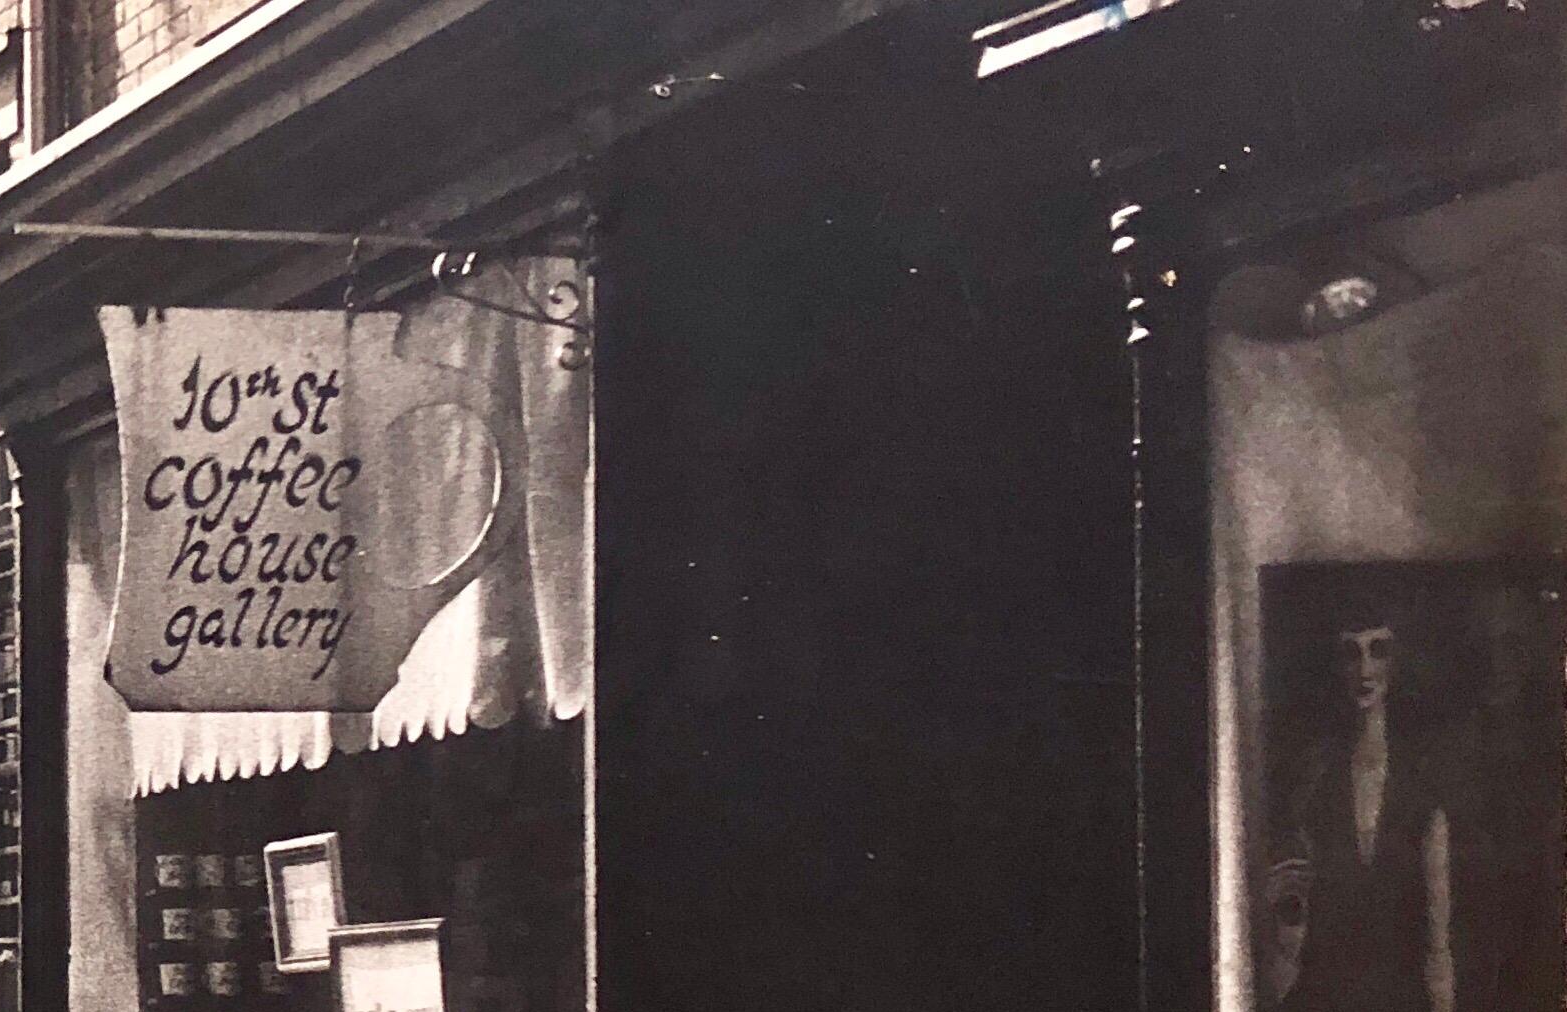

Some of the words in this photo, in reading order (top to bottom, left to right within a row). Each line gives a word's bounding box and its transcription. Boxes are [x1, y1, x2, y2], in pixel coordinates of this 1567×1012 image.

[173, 356, 281, 432] 10th
[272, 368, 339, 434] St
[144, 436, 362, 533] coffee
[167, 515, 357, 584] house
[150, 586, 354, 681] gallery
